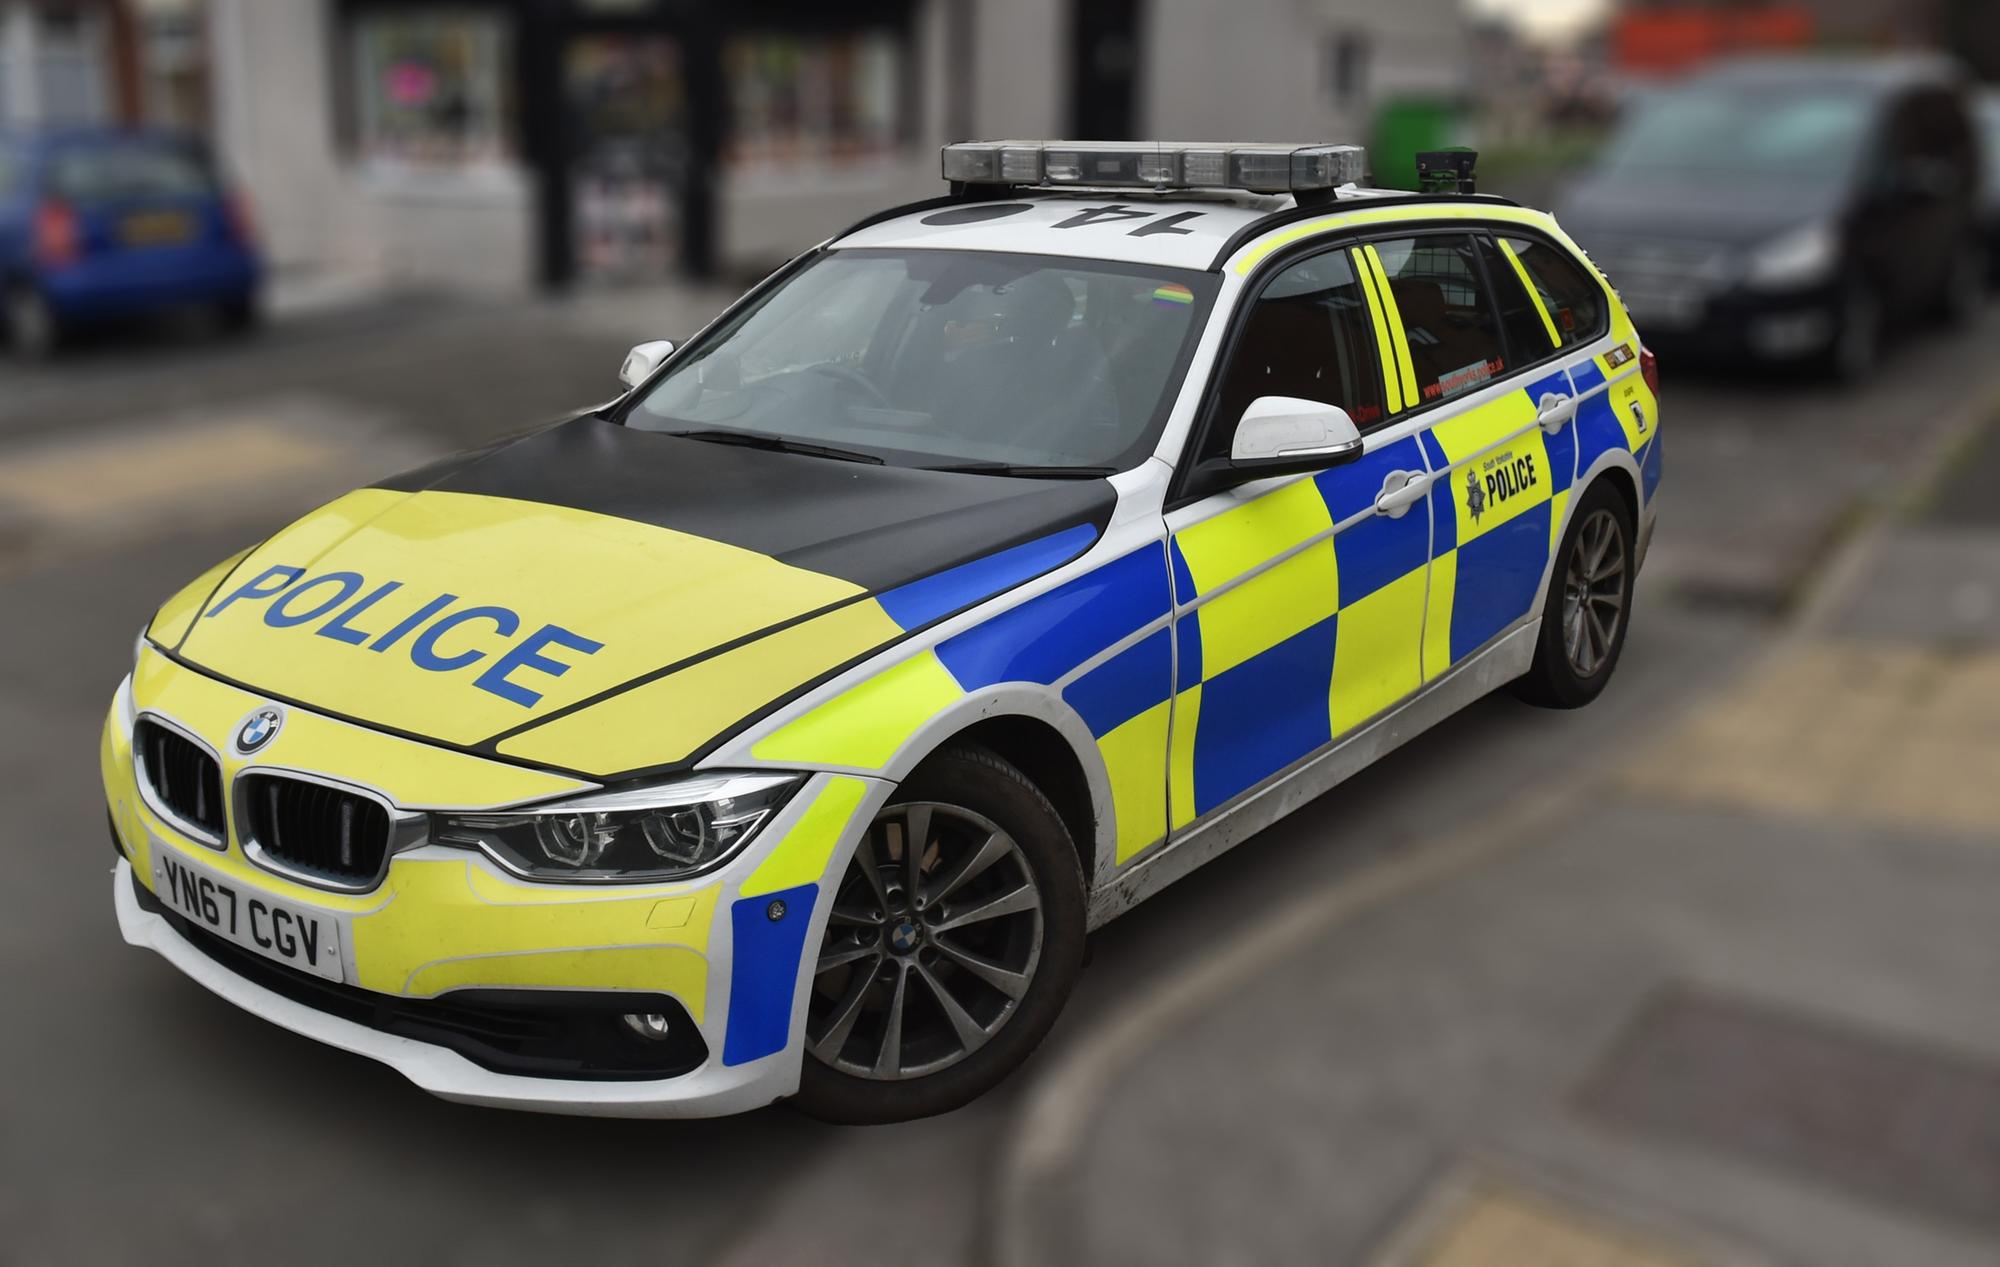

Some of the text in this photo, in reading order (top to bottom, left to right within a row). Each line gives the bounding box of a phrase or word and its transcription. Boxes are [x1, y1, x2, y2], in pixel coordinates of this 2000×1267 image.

[1050, 204, 1208, 237] 14
[1485, 453, 1537, 508] POLICE
[204, 564, 606, 709] POLICE
[163, 855, 318, 966] YN67 CGV
